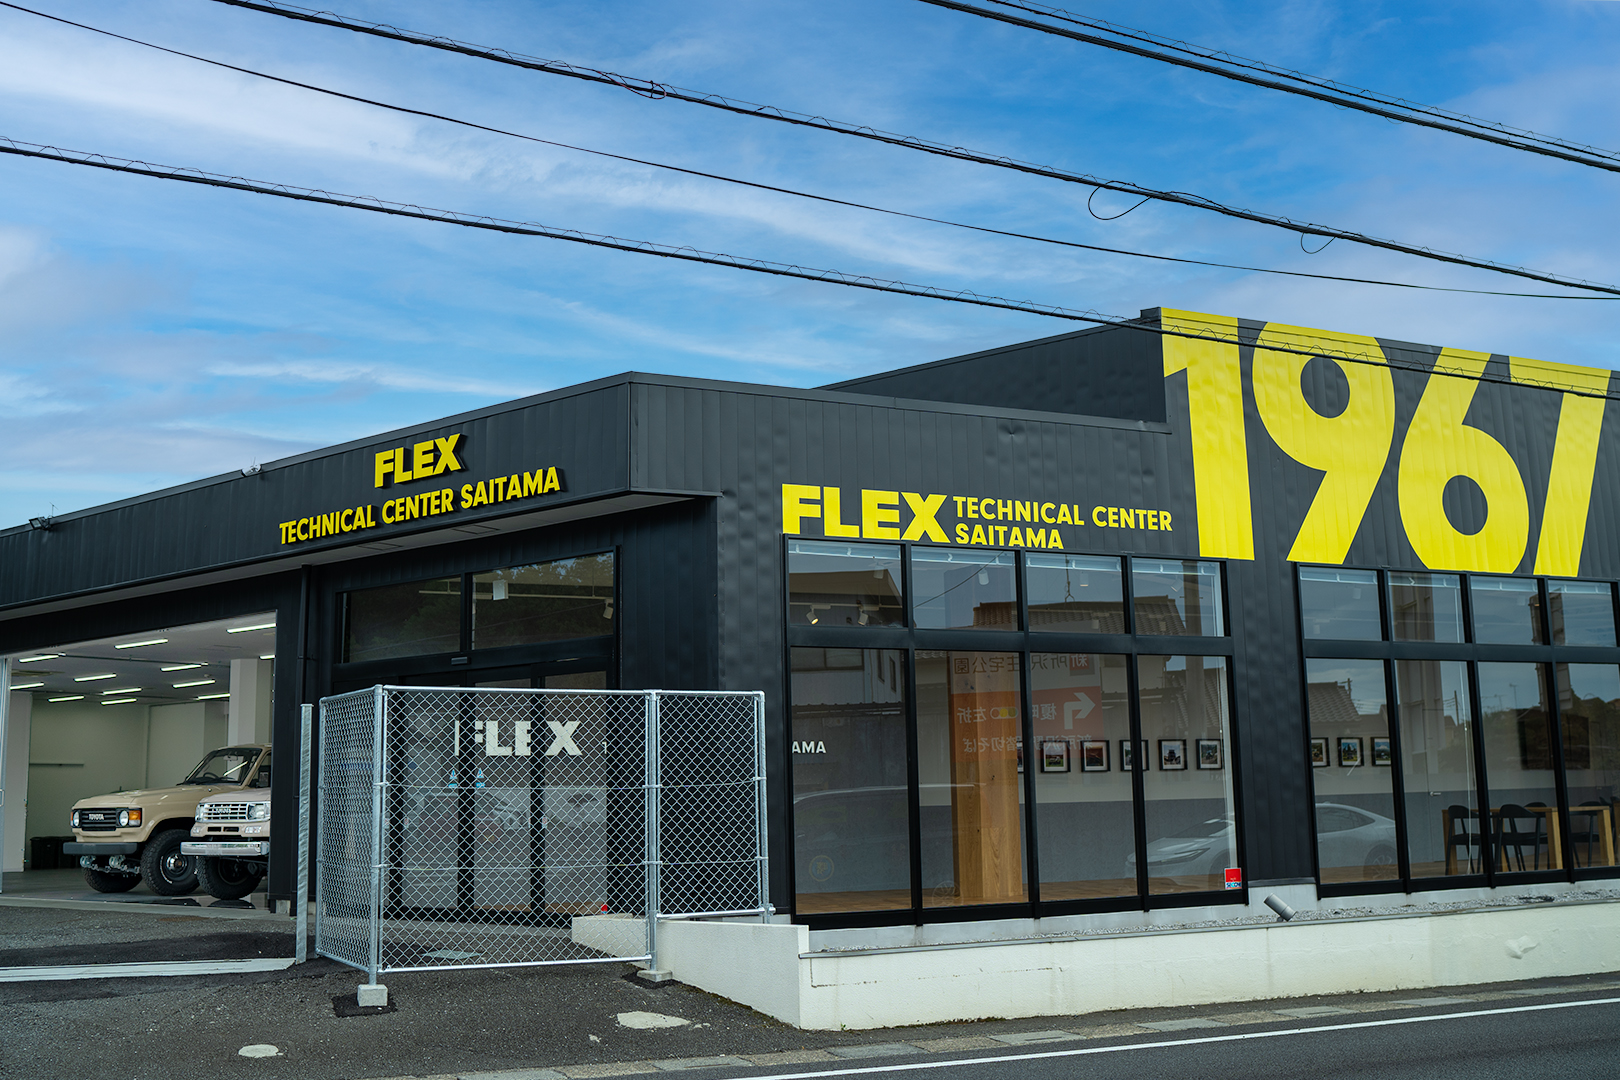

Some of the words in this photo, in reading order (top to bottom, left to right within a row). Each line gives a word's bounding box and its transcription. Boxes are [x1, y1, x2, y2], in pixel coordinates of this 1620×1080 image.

[374, 433, 462, 488] FLEX
[1161, 307, 1612, 578] 1967
[279, 504, 376, 545] TECHNICAL
[381, 488, 454, 525] CENTER
[460, 466, 561, 509] SAITAMA
[781, 483, 951, 544] FLEX
[952, 496, 1085, 526] TECHNICAL
[1091, 506, 1173, 532] CENTER
[955, 523, 1064, 550] SAITAMA
